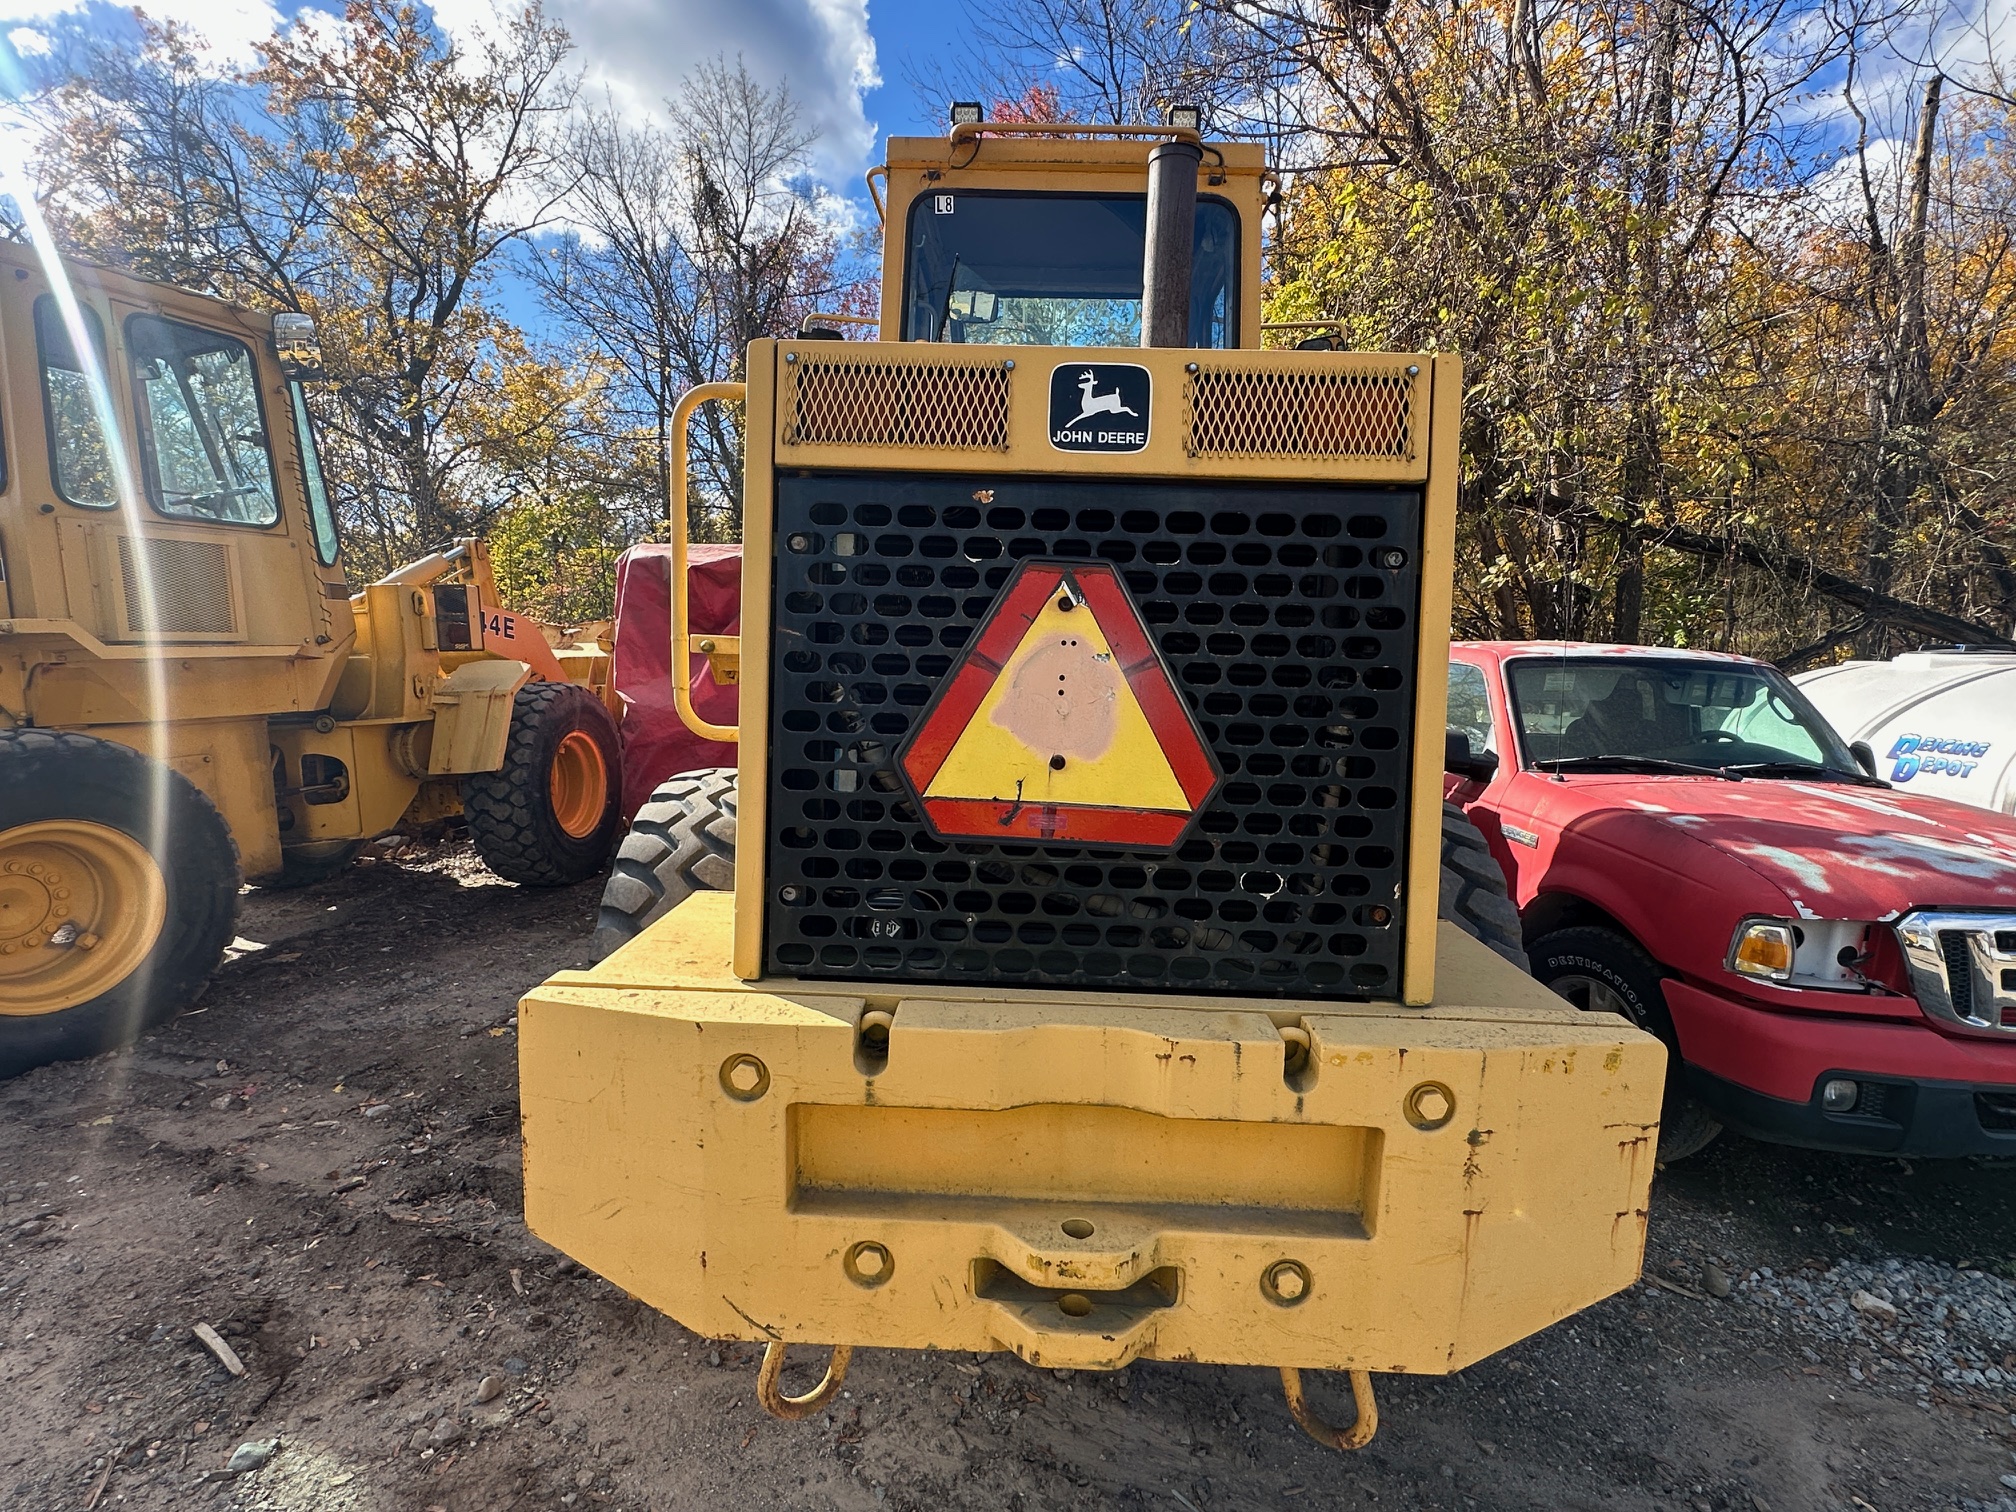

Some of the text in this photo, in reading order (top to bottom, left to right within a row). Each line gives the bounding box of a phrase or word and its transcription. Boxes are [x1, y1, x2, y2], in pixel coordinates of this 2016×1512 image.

[936, 196, 952, 213] L8
[1052, 430, 1145, 444] JOHN DEERE
[1886, 733, 1991, 758] DEICING
[1890, 753, 1978, 783] DEPOT
[1548, 955, 1646, 1016] DESTINATION
